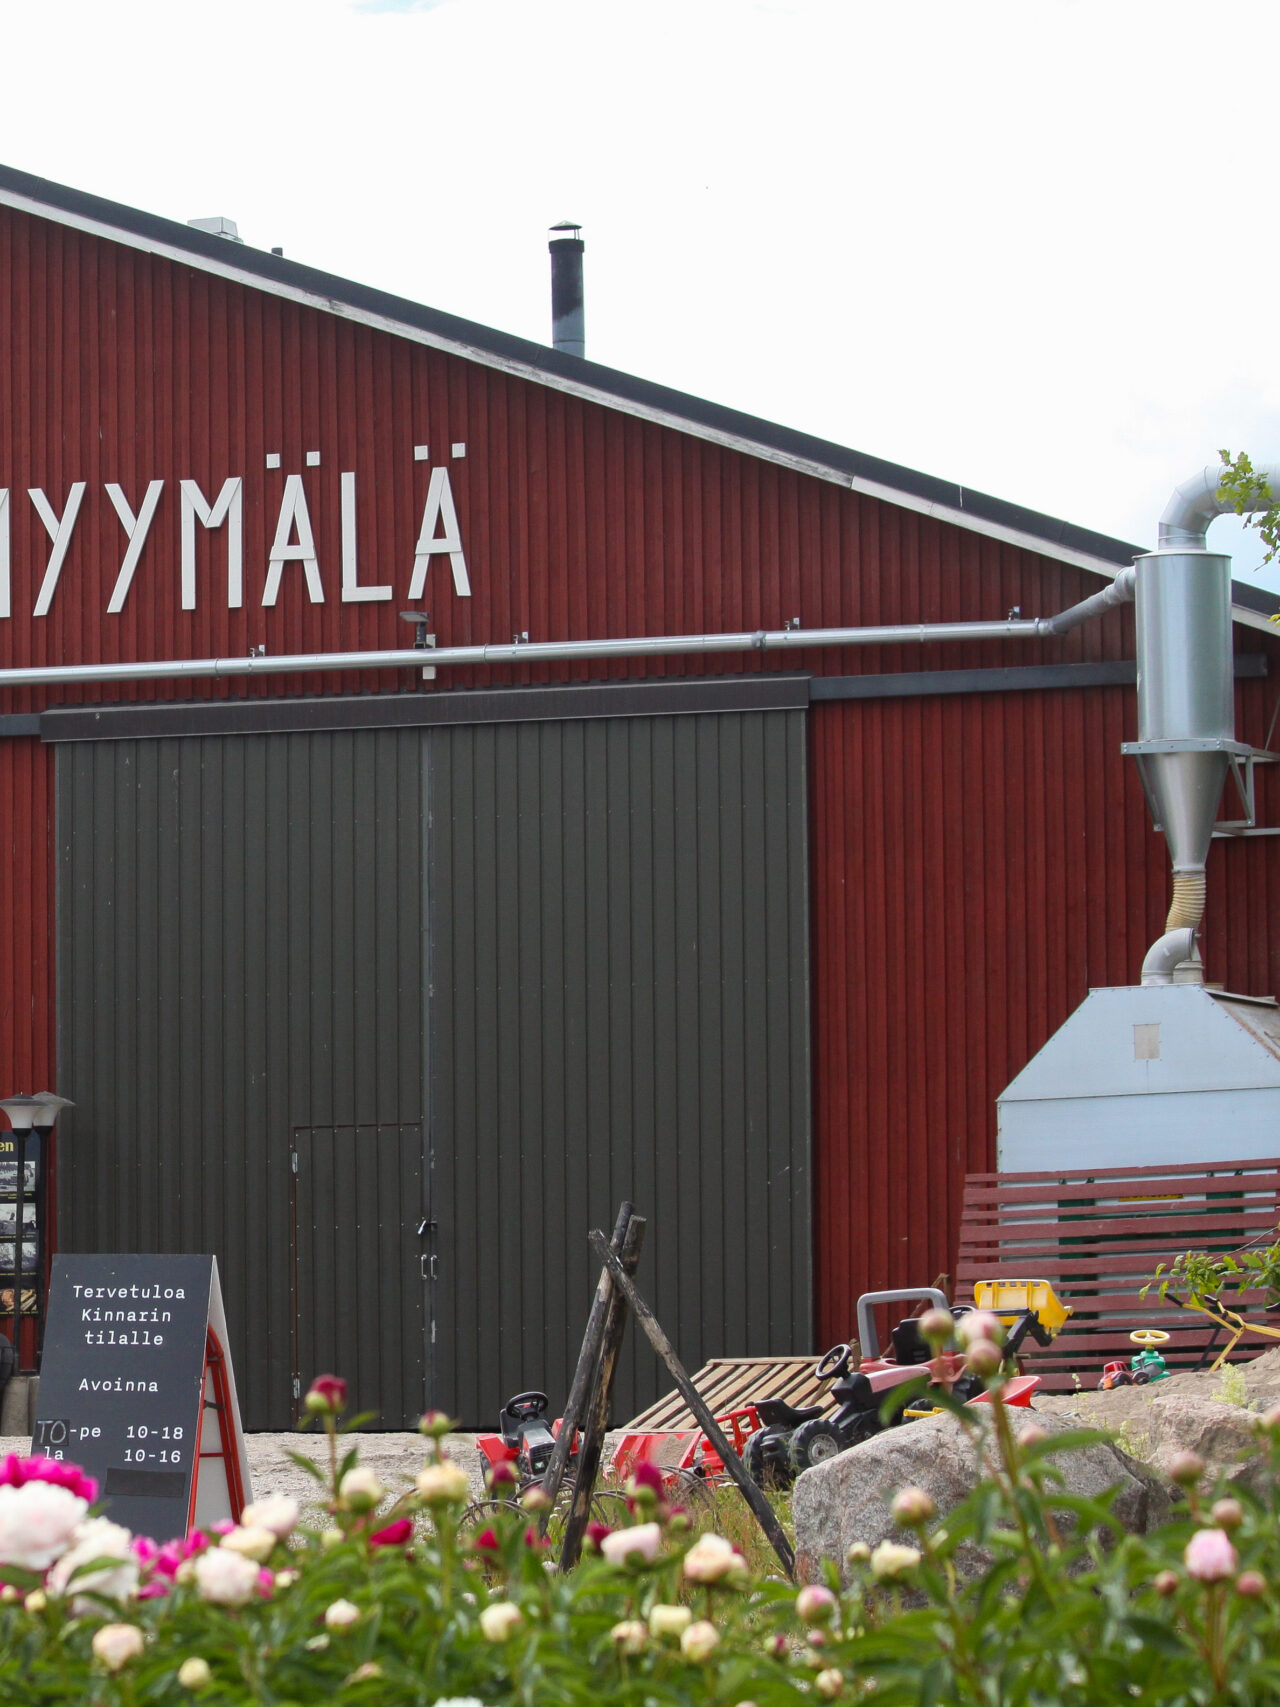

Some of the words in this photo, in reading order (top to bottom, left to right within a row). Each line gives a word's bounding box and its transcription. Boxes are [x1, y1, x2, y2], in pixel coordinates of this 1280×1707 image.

[72, 1284, 186, 1300] Tervetuloa
[81, 1307, 172, 1322] Kinnarin
[84, 1330, 164, 1346] tilalle
[78, 1377, 159, 1393] Avoinna
[126, 1425, 184, 1440] 10-18
[43, 1446, 64, 1461] la
[123, 1448, 182, 1464] 10-16
